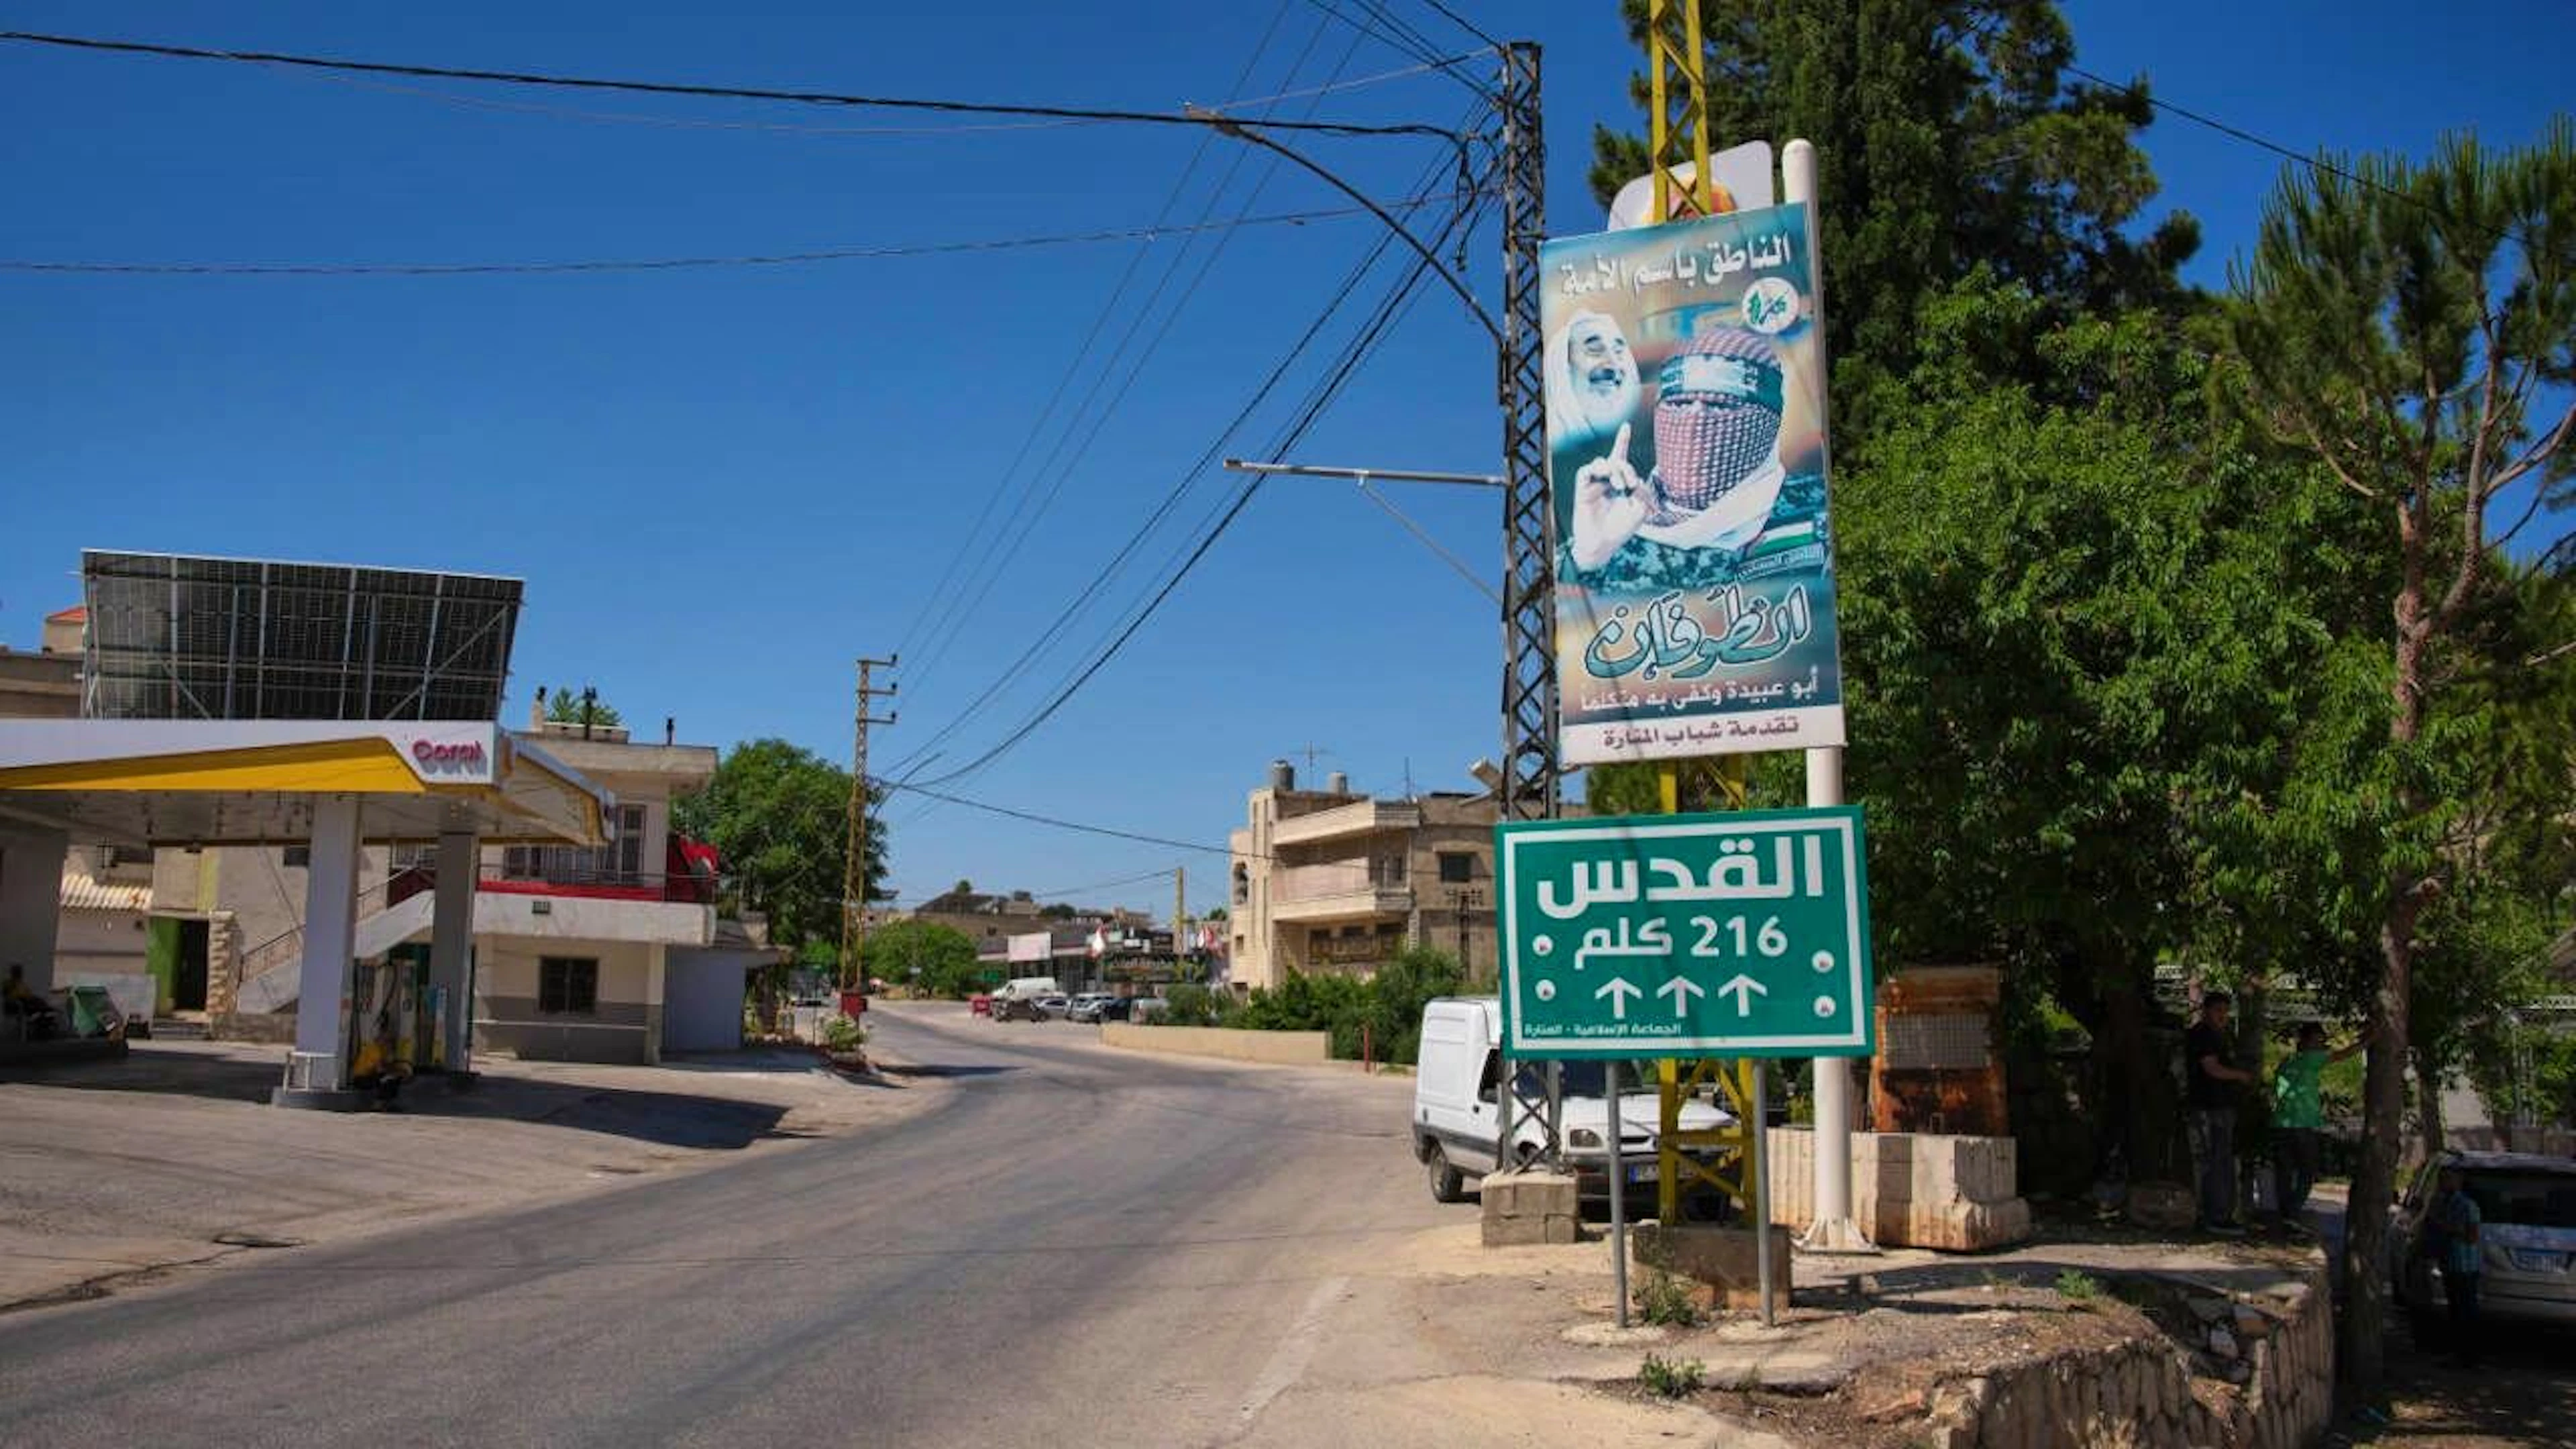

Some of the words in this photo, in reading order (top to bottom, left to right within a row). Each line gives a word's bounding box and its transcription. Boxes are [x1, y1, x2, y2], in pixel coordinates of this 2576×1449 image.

[1631, 248, 1697, 294] باسم
[1703, 231, 1790, 284] الناطق
[1725, 680, 1786, 704] عبيدة
[1791, 664, 1819, 700] أبو
[1603, 728, 1660, 748] المنارة
[1664, 721, 1722, 747] شباب
[1727, 716, 1799, 737] تقدمة
[1537, 835, 1823, 919] القدس
[1574, 916, 1673, 970] كلم
[1689, 915, 1789, 957] 216
[1631, 1023, 1682, 1035] الجماعة
